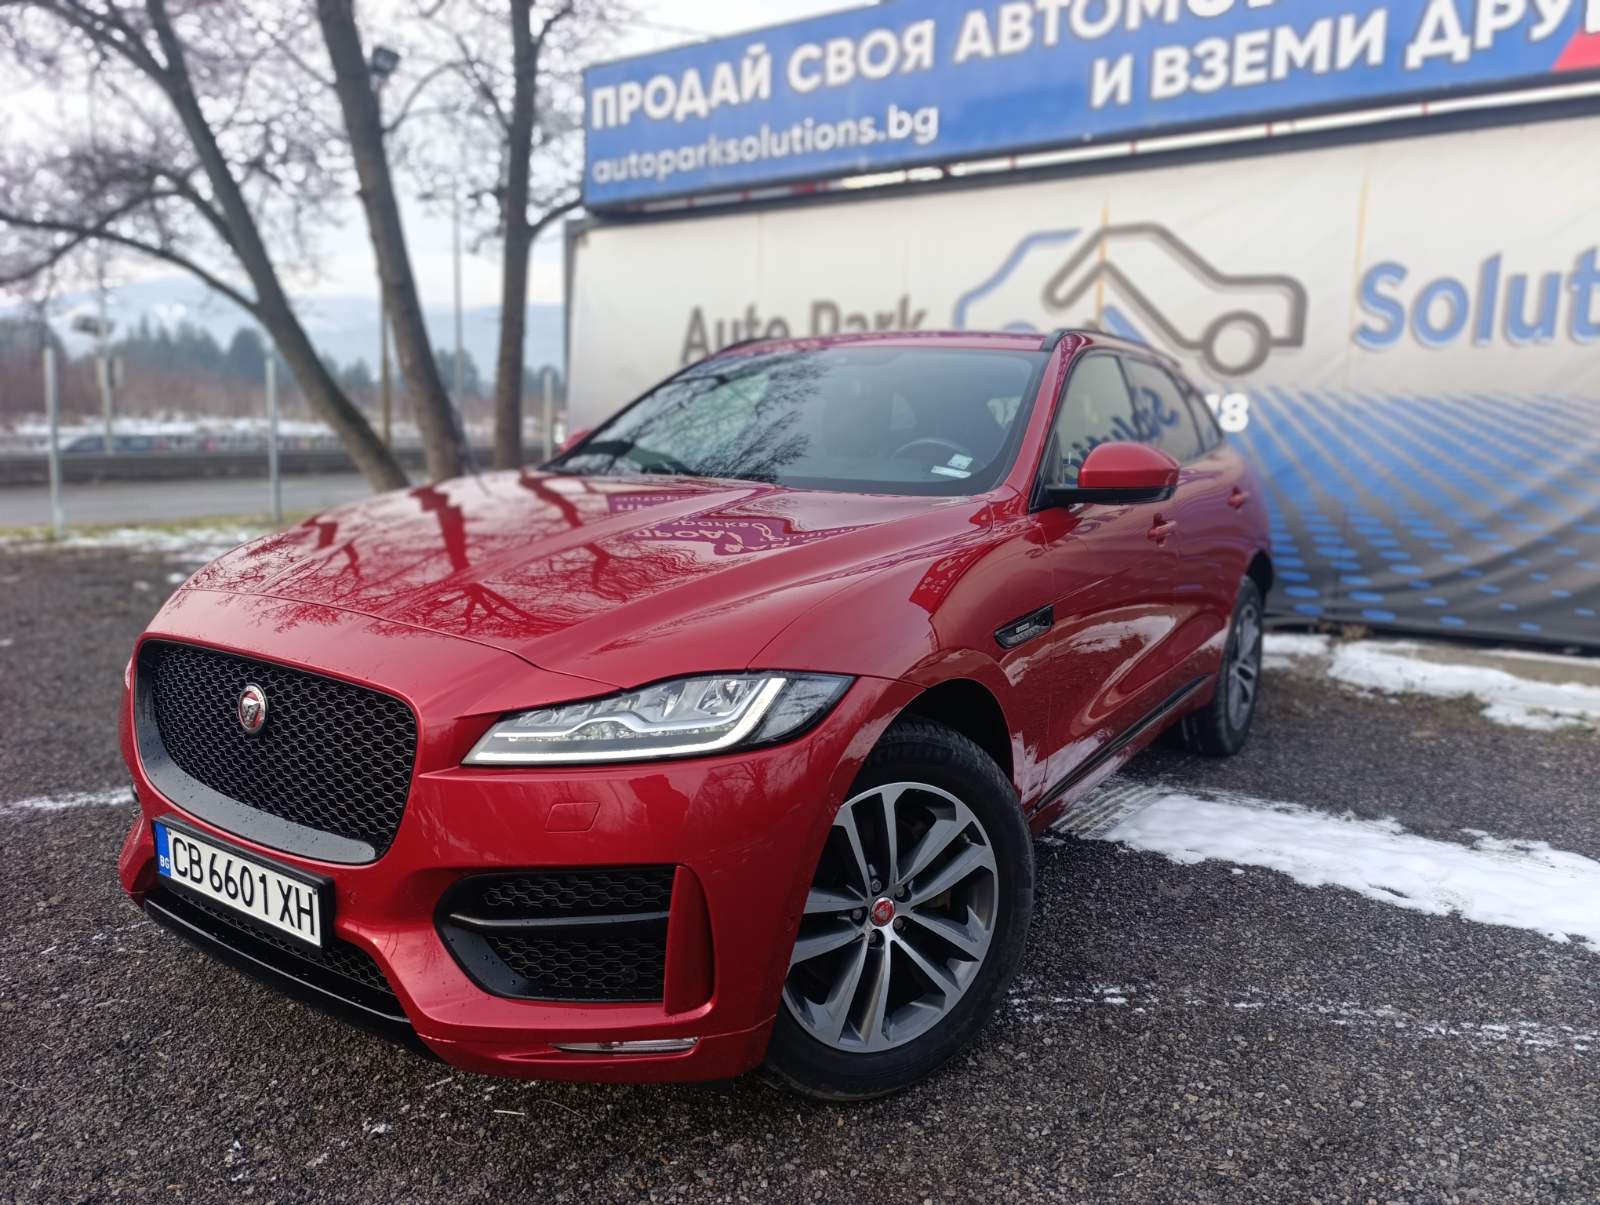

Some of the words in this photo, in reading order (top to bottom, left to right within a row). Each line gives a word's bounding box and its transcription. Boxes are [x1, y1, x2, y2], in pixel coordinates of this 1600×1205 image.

[592, 43, 771, 130] ПРОДАЙ
[787, 19, 936, 93] СВОЯ
[1091, 53, 1134, 108] И
[1150, 9, 1388, 100] ВЗЕМИ
[592, 105, 939, 184] autoparksolutions.bg
[680, 303, 790, 365] Auto
[1351, 245, 1600, 349] Solut
[159, 854, 170, 869] BG
